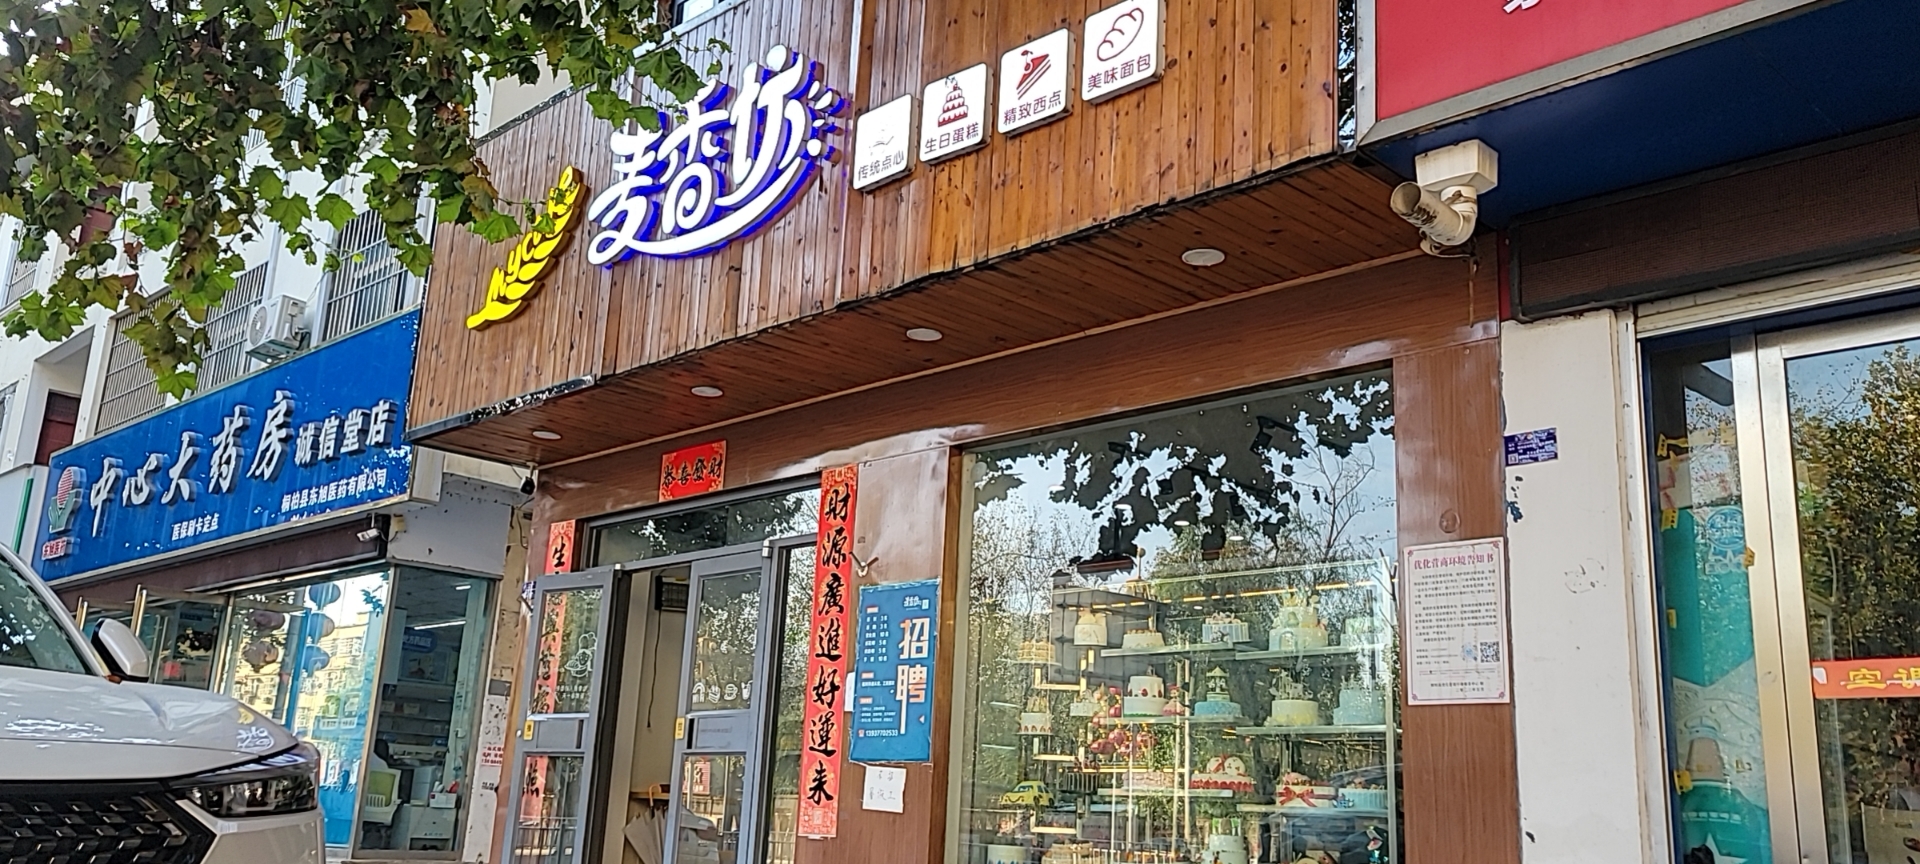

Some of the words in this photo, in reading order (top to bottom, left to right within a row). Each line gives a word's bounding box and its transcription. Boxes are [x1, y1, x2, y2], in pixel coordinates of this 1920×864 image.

[1087, 54, 1151, 93] 美味面包
[1003, 90, 1062, 126] 精致西点
[924, 122, 980, 155] 生日蛋糕
[858, 150, 905, 182] 传统点心
[91, 390, 293, 537] 中心大药房
[294, 399, 397, 467] 诚信堂店
[662, 454, 723, 489] 恭喜發財
[281, 467, 387, 513] 桐柏县东旭医药有限公司
[172, 513, 219, 541] 医保刷卡定点
[1414, 553, 1494, 570] 优化营商环境告知书
[896, 617, 931, 734] 招聘
